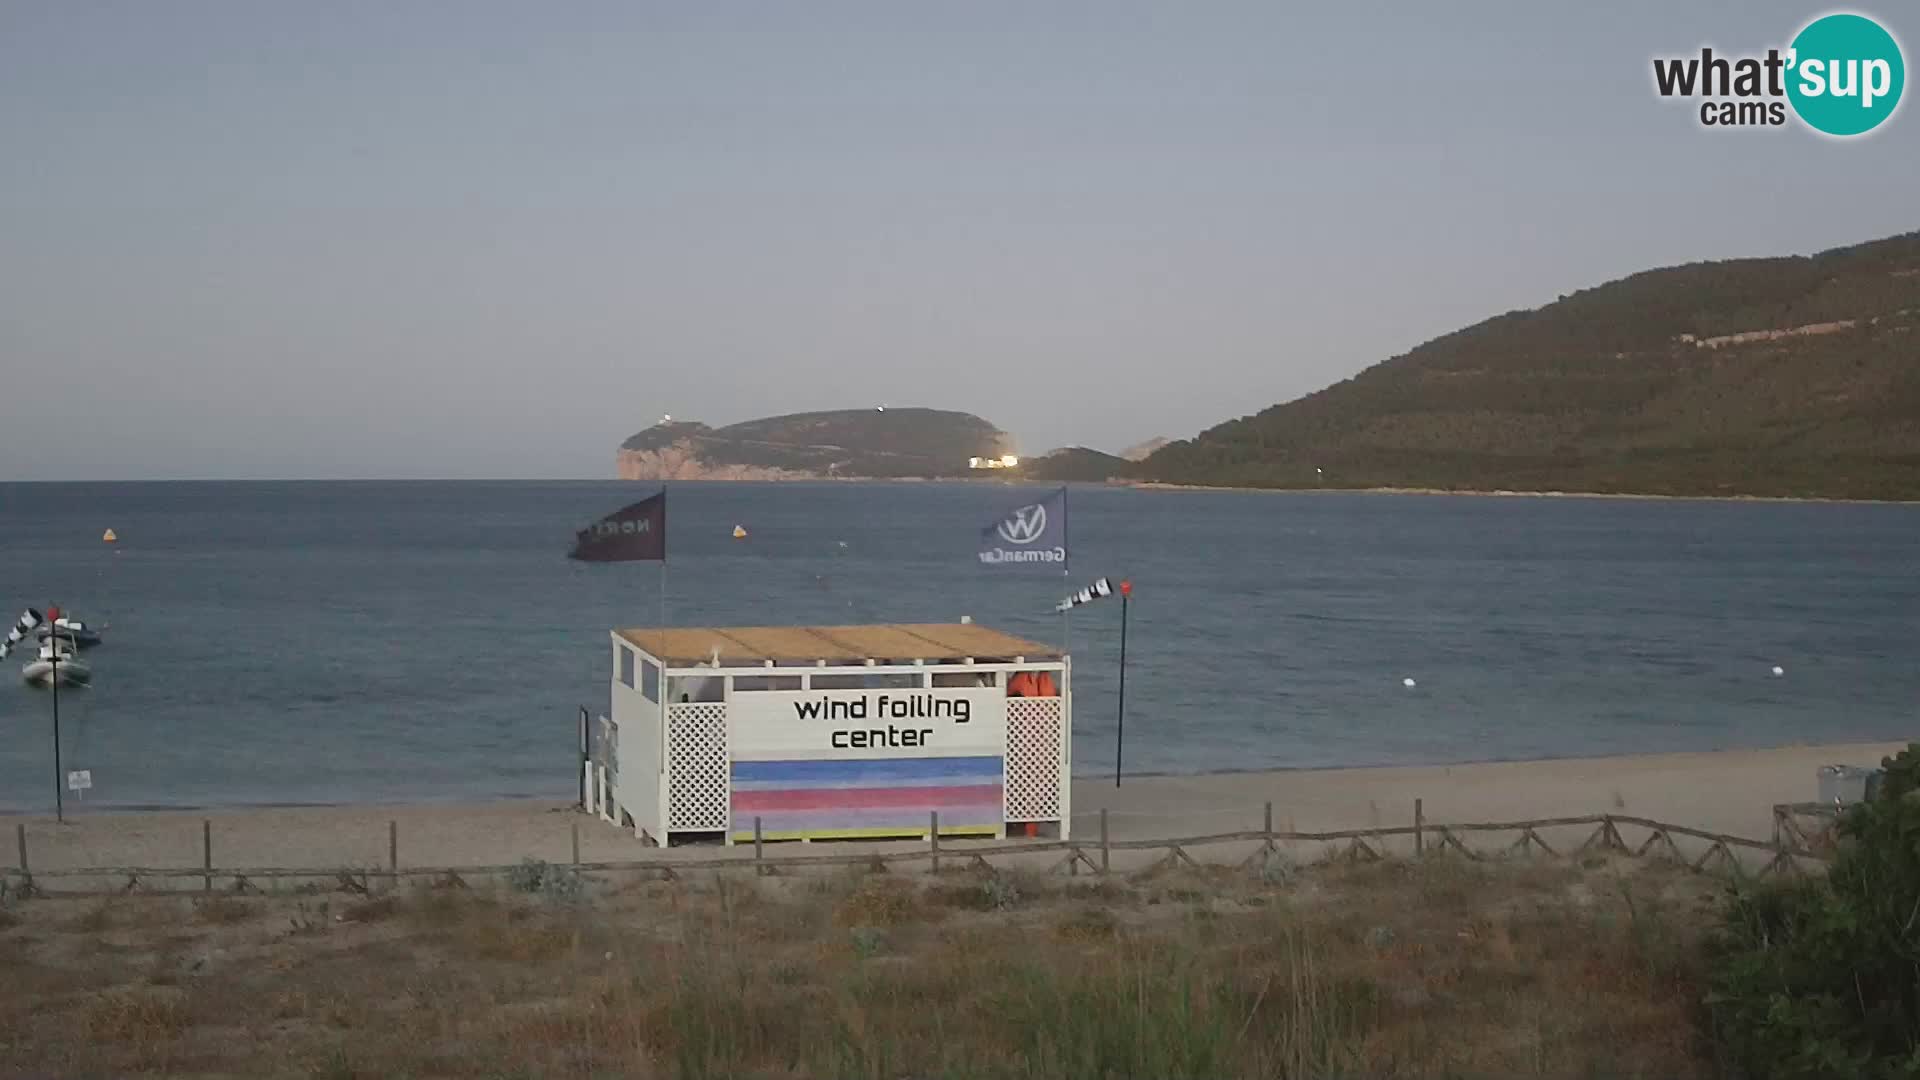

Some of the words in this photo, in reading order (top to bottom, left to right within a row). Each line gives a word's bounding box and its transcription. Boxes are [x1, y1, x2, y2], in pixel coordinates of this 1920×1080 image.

[794, 695, 867, 721] wind
[877, 693, 971, 723] foiling
[831, 724, 934, 749] center
